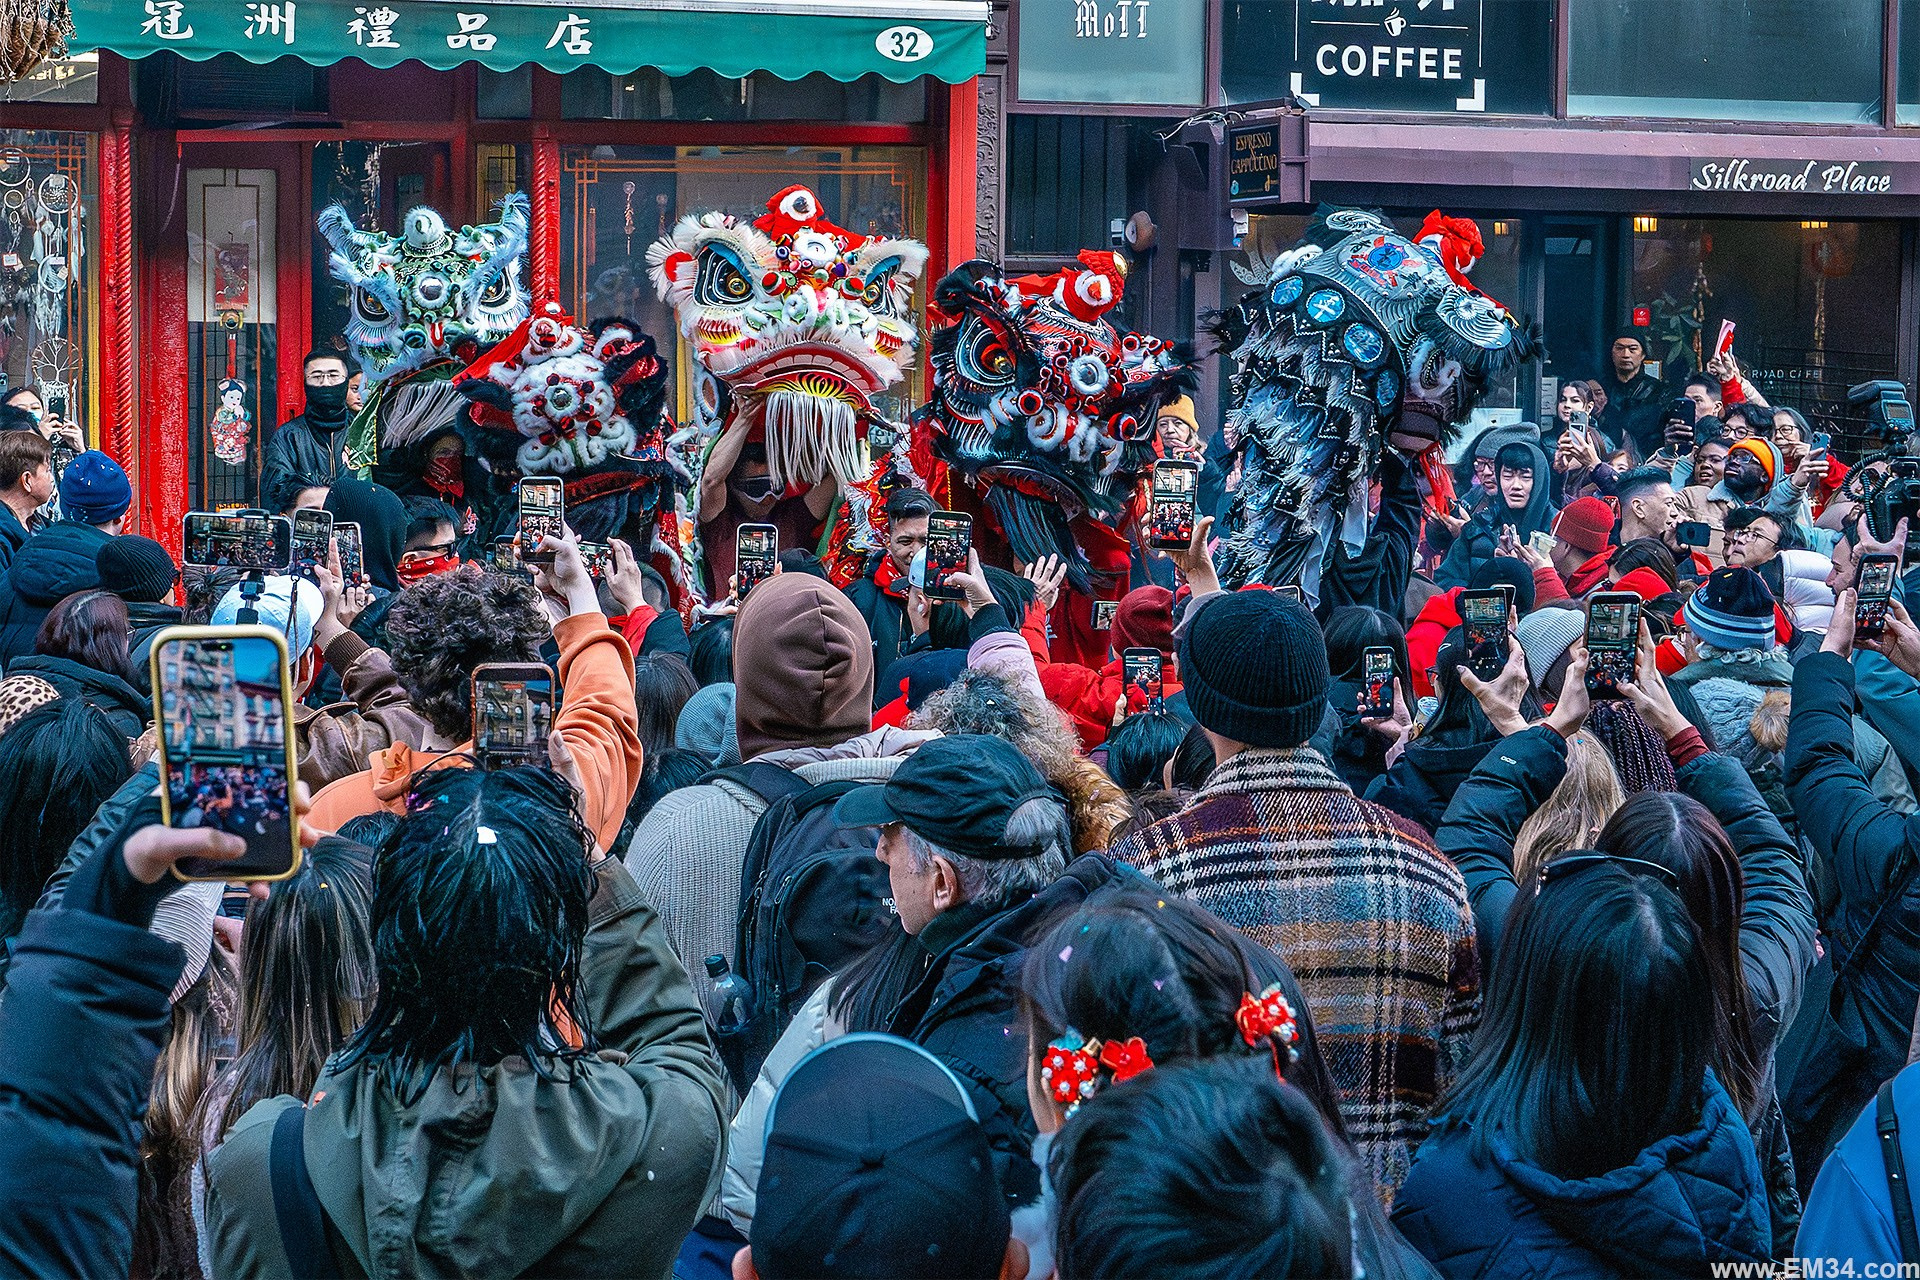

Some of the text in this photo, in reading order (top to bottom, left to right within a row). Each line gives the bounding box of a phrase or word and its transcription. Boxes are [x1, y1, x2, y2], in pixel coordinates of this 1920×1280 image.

[890, 31, 919, 57] 32
[1316, 44, 1462, 80] COFFEE
[1235, 131, 1272, 151] ESPRESSO
[1231, 154, 1278, 175] CAPPUCCINO
[1692, 158, 1892, 192] Silkroad Place
